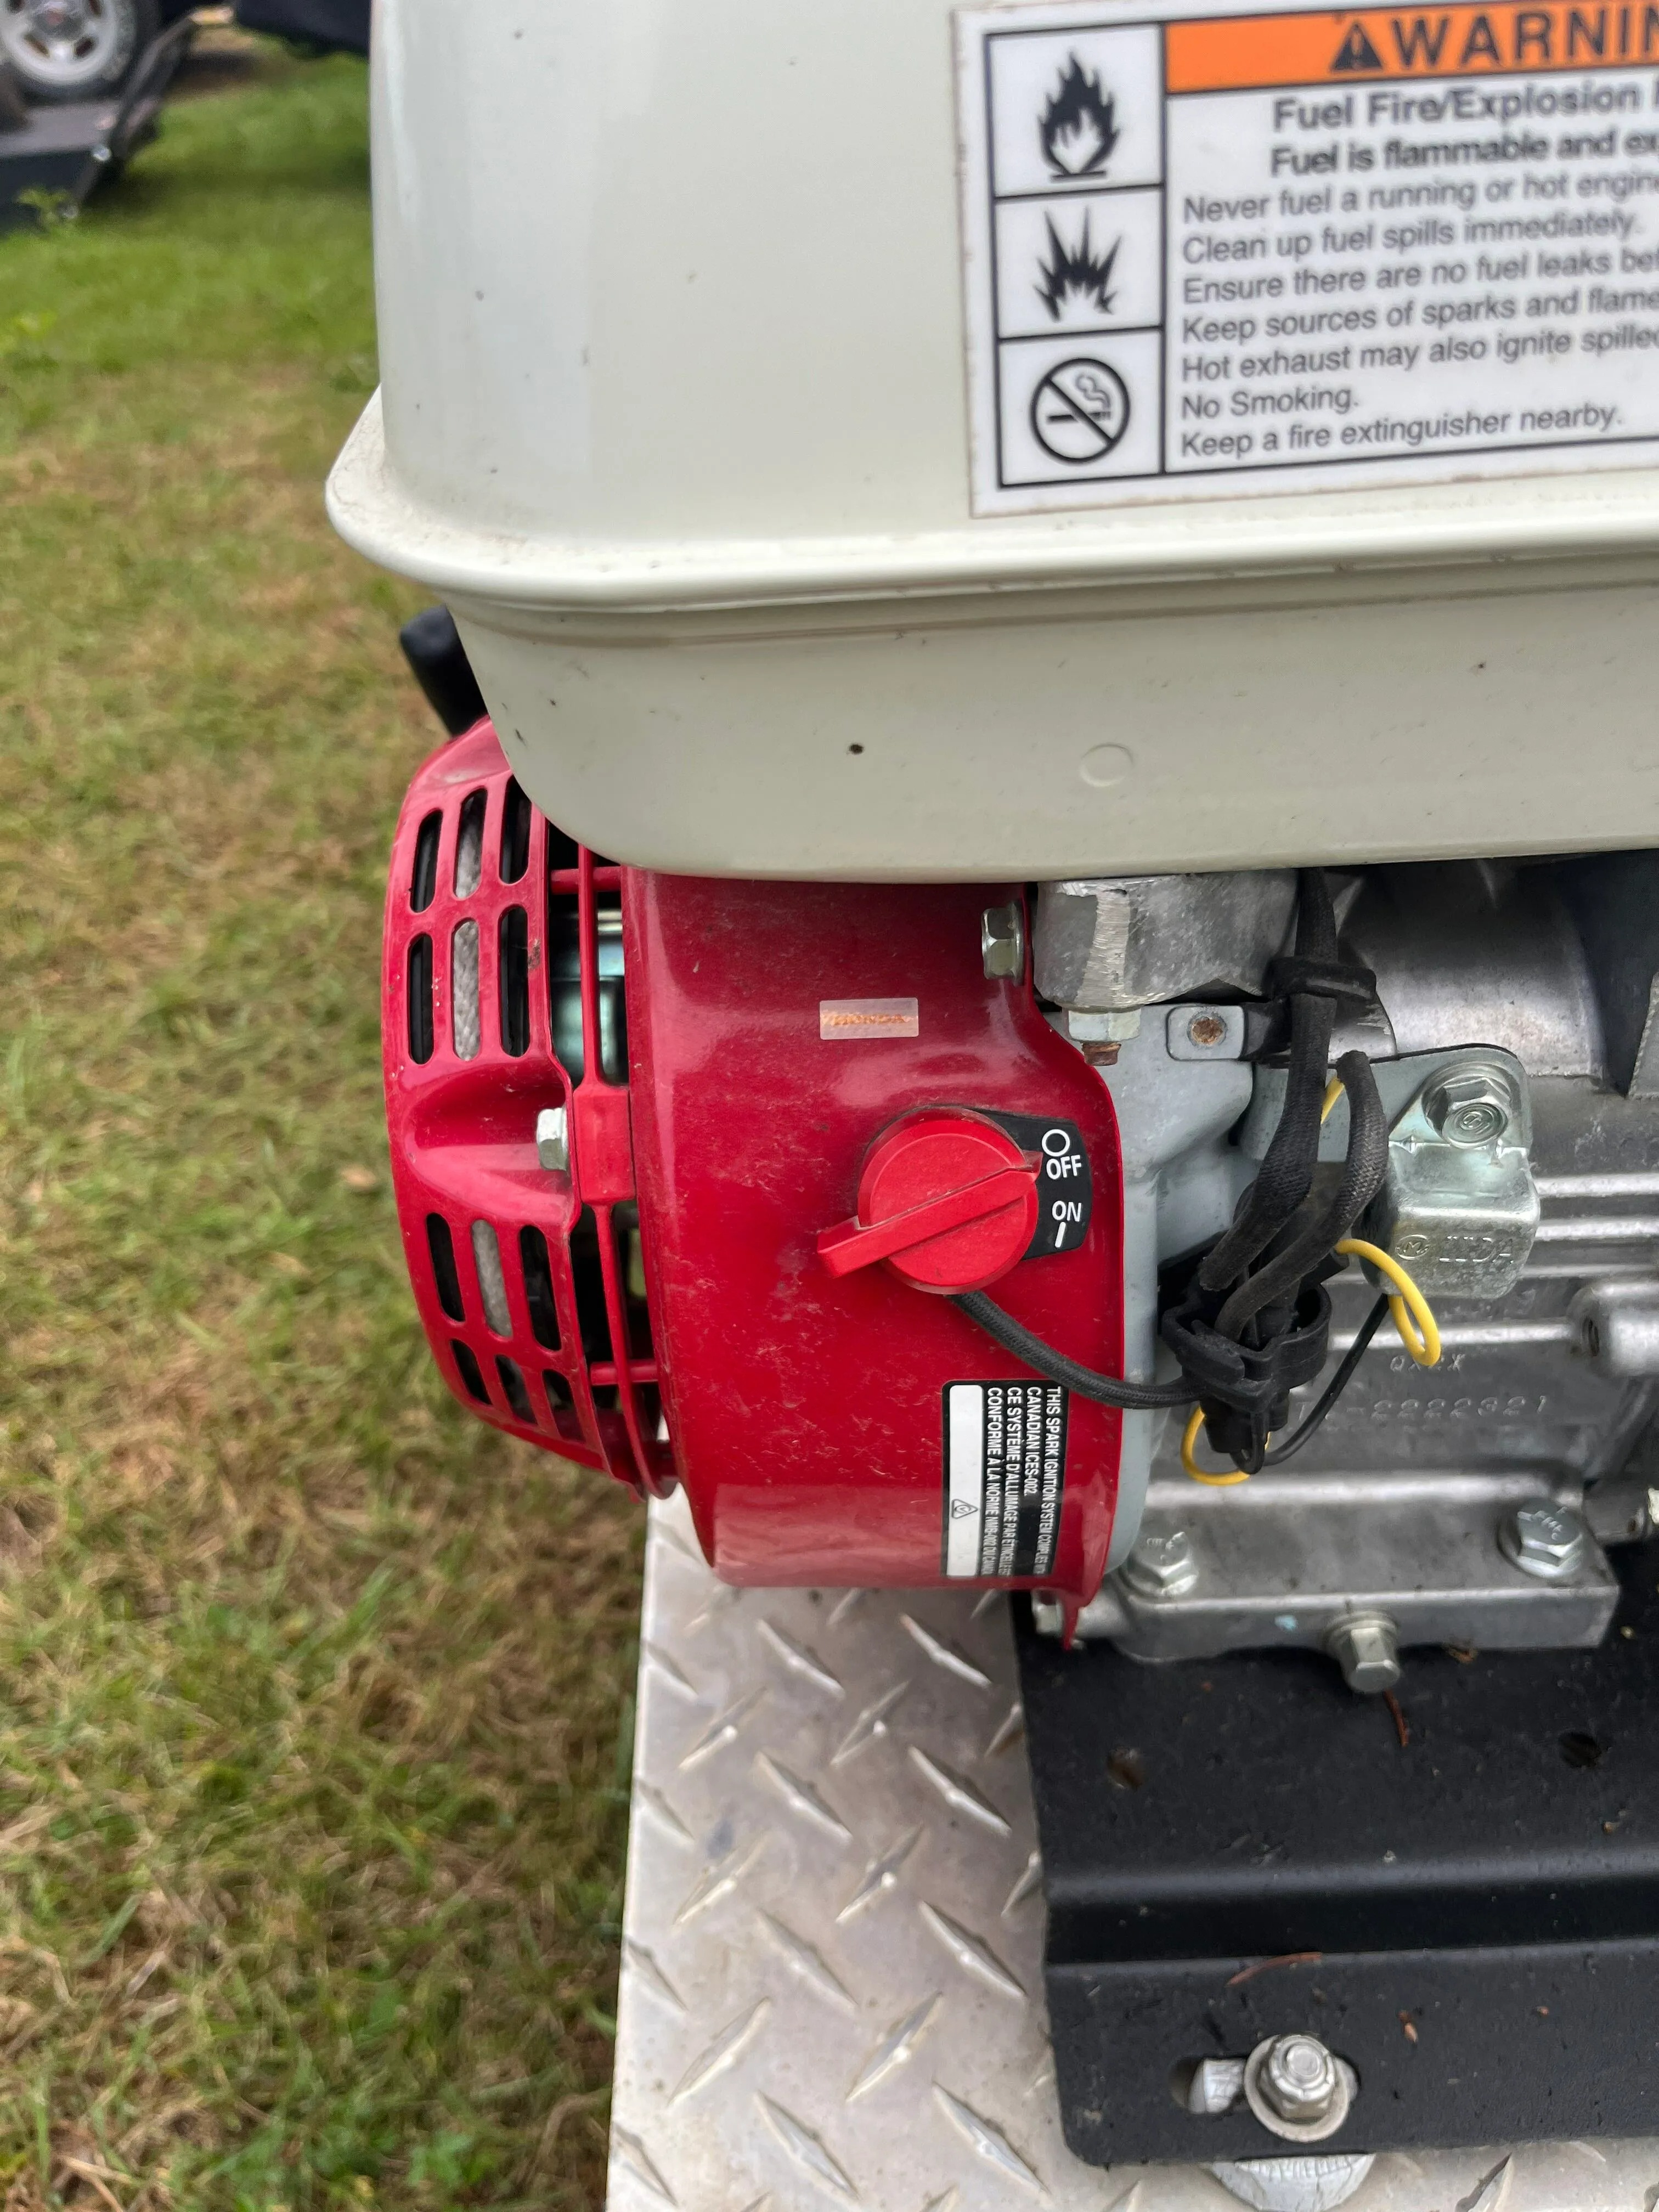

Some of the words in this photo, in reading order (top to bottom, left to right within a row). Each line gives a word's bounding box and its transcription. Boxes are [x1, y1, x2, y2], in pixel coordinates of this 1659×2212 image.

[1274, 93, 1353, 132] Fuel
[1369, 80, 1640, 125] Fire/Explosion
[1271, 142, 1338, 178] Fuel
[1348, 142, 1375, 172] is
[1384, 131, 1547, 169] flammable
[1558, 129, 1617, 160] and
[1183, 196, 1269, 223] Never
[1279, 184, 1331, 216] fuel
[1341, 190, 1358, 212] a
[1369, 180, 1475, 210] running
[1485, 179, 1514, 202] or
[1522, 172, 1570, 200] hot
[1183, 233, 1266, 264] Clean
[1276, 233, 1312, 262] up
[1322, 224, 1374, 254] fuel
[1382, 218, 1454, 255] spills
[1183, 276, 1283, 304] Ensure
[1294, 268, 1366, 295] there
[1376, 266, 1421, 290] are
[1431, 262, 1466, 285] no
[1477, 251, 1528, 281] fuel
[1537, 249, 1611, 278] leaks
[1183, 315, 1256, 346] Keep
[1264, 307, 1377, 337] sources
[1386, 299, 1414, 328] of
[1421, 292, 1516, 330] sparks
[1525, 286, 1581, 318] and
[1182, 354, 1231, 382] Hot
[1239, 346, 1350, 379] exhaust
[1359, 344, 1420, 372] may
[1429, 335, 1486, 363] also
[1496, 329, 1571, 364] ignite
[1182, 394, 1221, 420] No
[1230, 385, 1359, 415] Smoking.
[1182, 432, 1252, 459] Keep
[1263, 432, 1279, 452] a
[1289, 424, 1330, 450] fire
[1340, 410, 1510, 447] extinguisher
[1520, 402, 1623, 432] nearby.
[1046, 1154, 1082, 1180] OFF
[1051, 1200, 1082, 1222] ON
[1007, 1387, 1023, 1404] CE
[1026, 1386, 1042, 1449] CANADIAN
[1046, 1386, 1062, 1414] THIS
[987, 1387, 1003, 1455] CONFORME
[1006, 1407, 1025, 1462] SYSTÈME
[1045, 1417, 1061, 1457] SPARK
[986, 1467, 1002, 1481] LA
[987, 1457, 1005, 1465] À
[1024, 1452, 1041, 1497] ICES-002.
[1042, 1458, 1059, 1502] IGNITION
[985, 1482, 1001, 1516] NORME
[1003, 1463, 1020, 1523] D'ALLUMAGE
[983, 1516, 999, 1546] NMB-002
[1002, 1523, 1017, 1539] PAR
[1039, 1502, 1056, 1534] SYSTEM
[982, 1546, 997, 1556] DU
